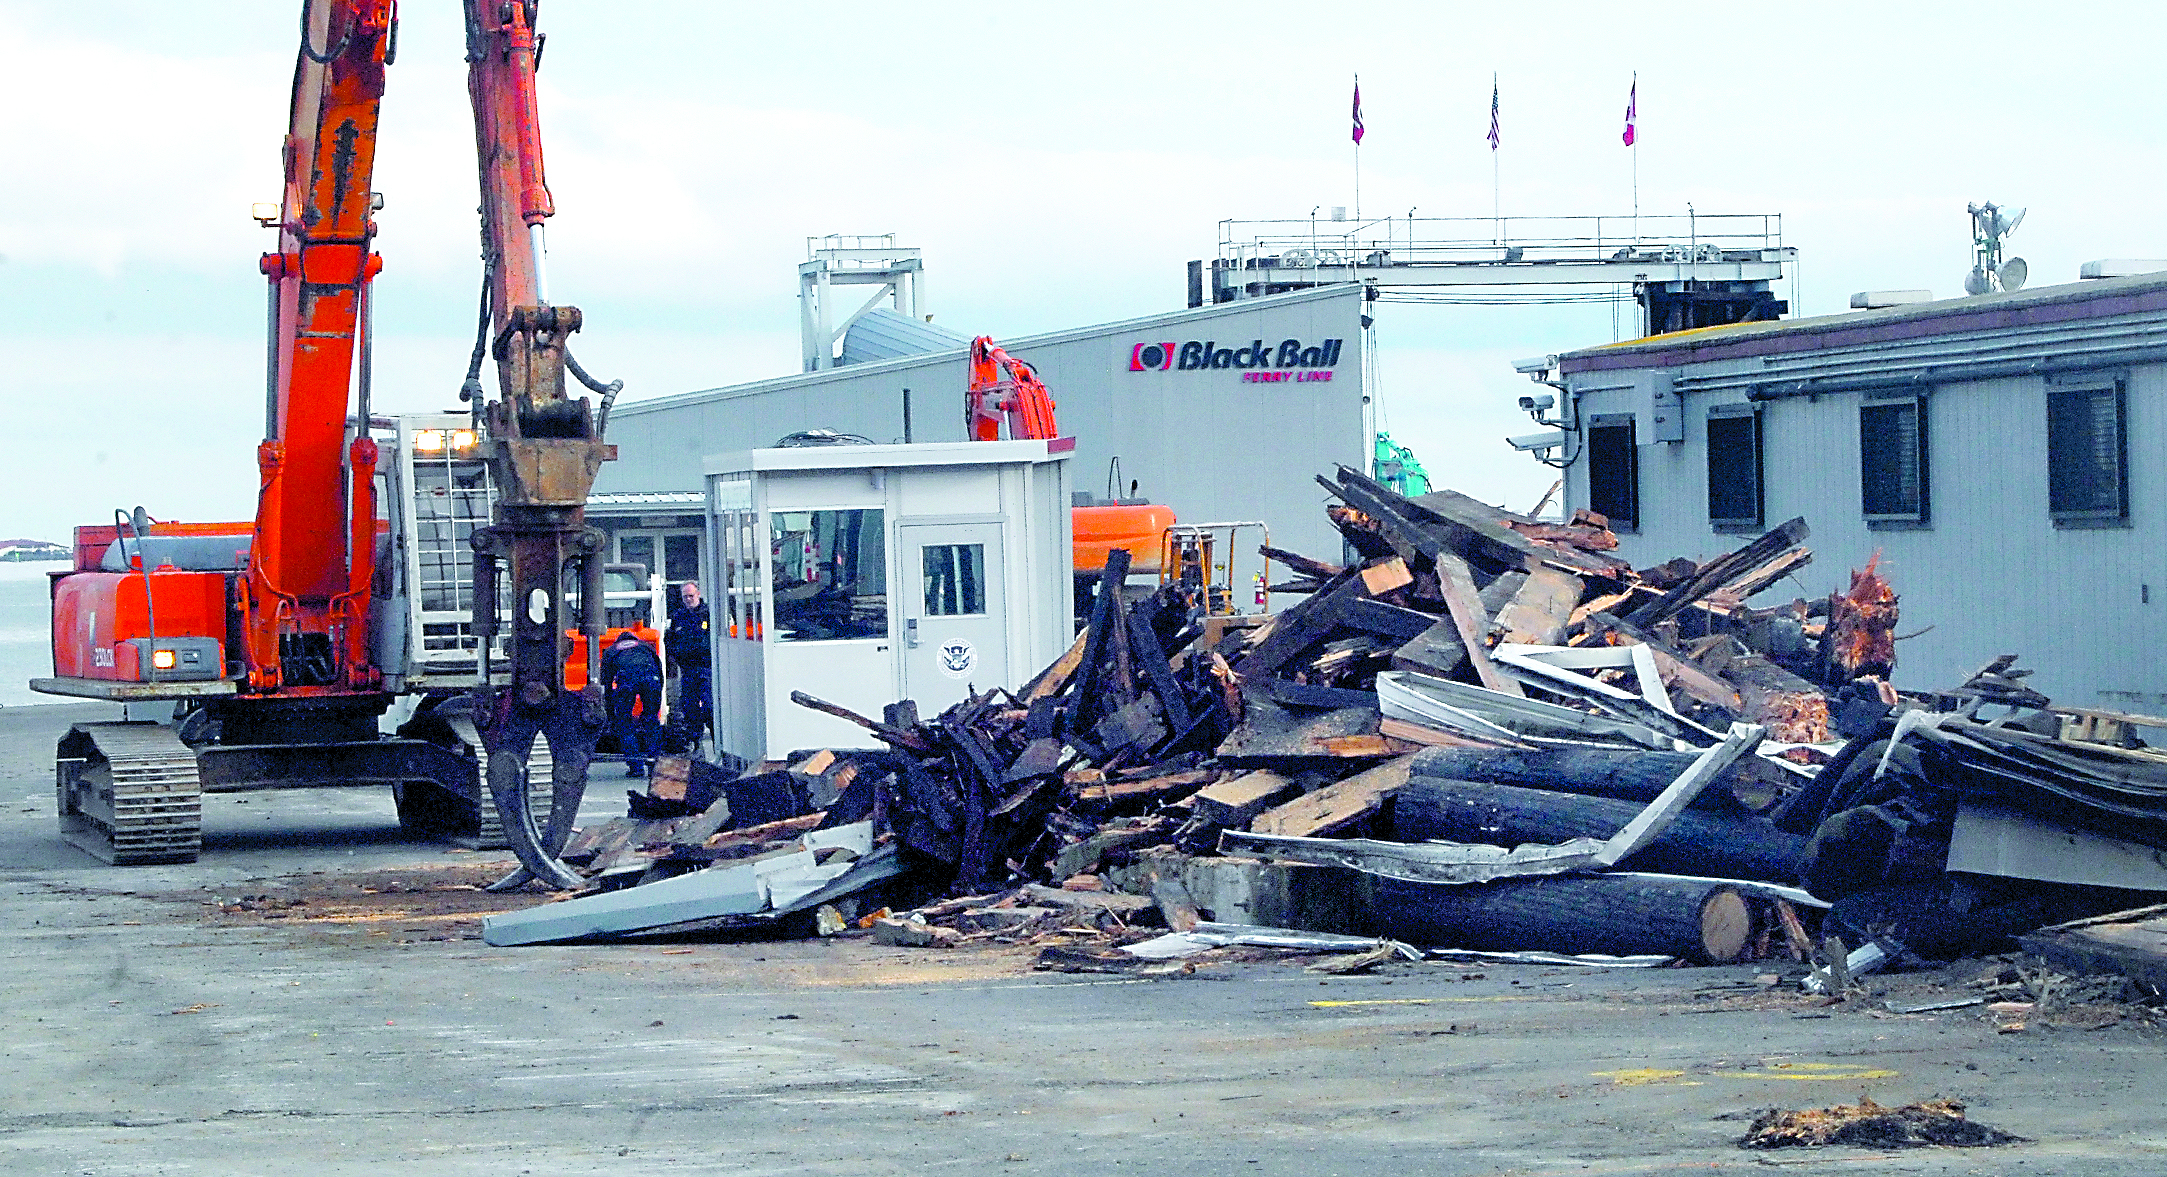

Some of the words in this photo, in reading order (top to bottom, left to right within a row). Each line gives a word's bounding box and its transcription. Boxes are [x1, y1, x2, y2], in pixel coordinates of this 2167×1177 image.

[1178, 340, 1273, 370] Black
[1276, 338, 1343, 368] Ball
[1243, 371, 1293, 383] FERRY
[1297, 370, 1333, 382] LINE
